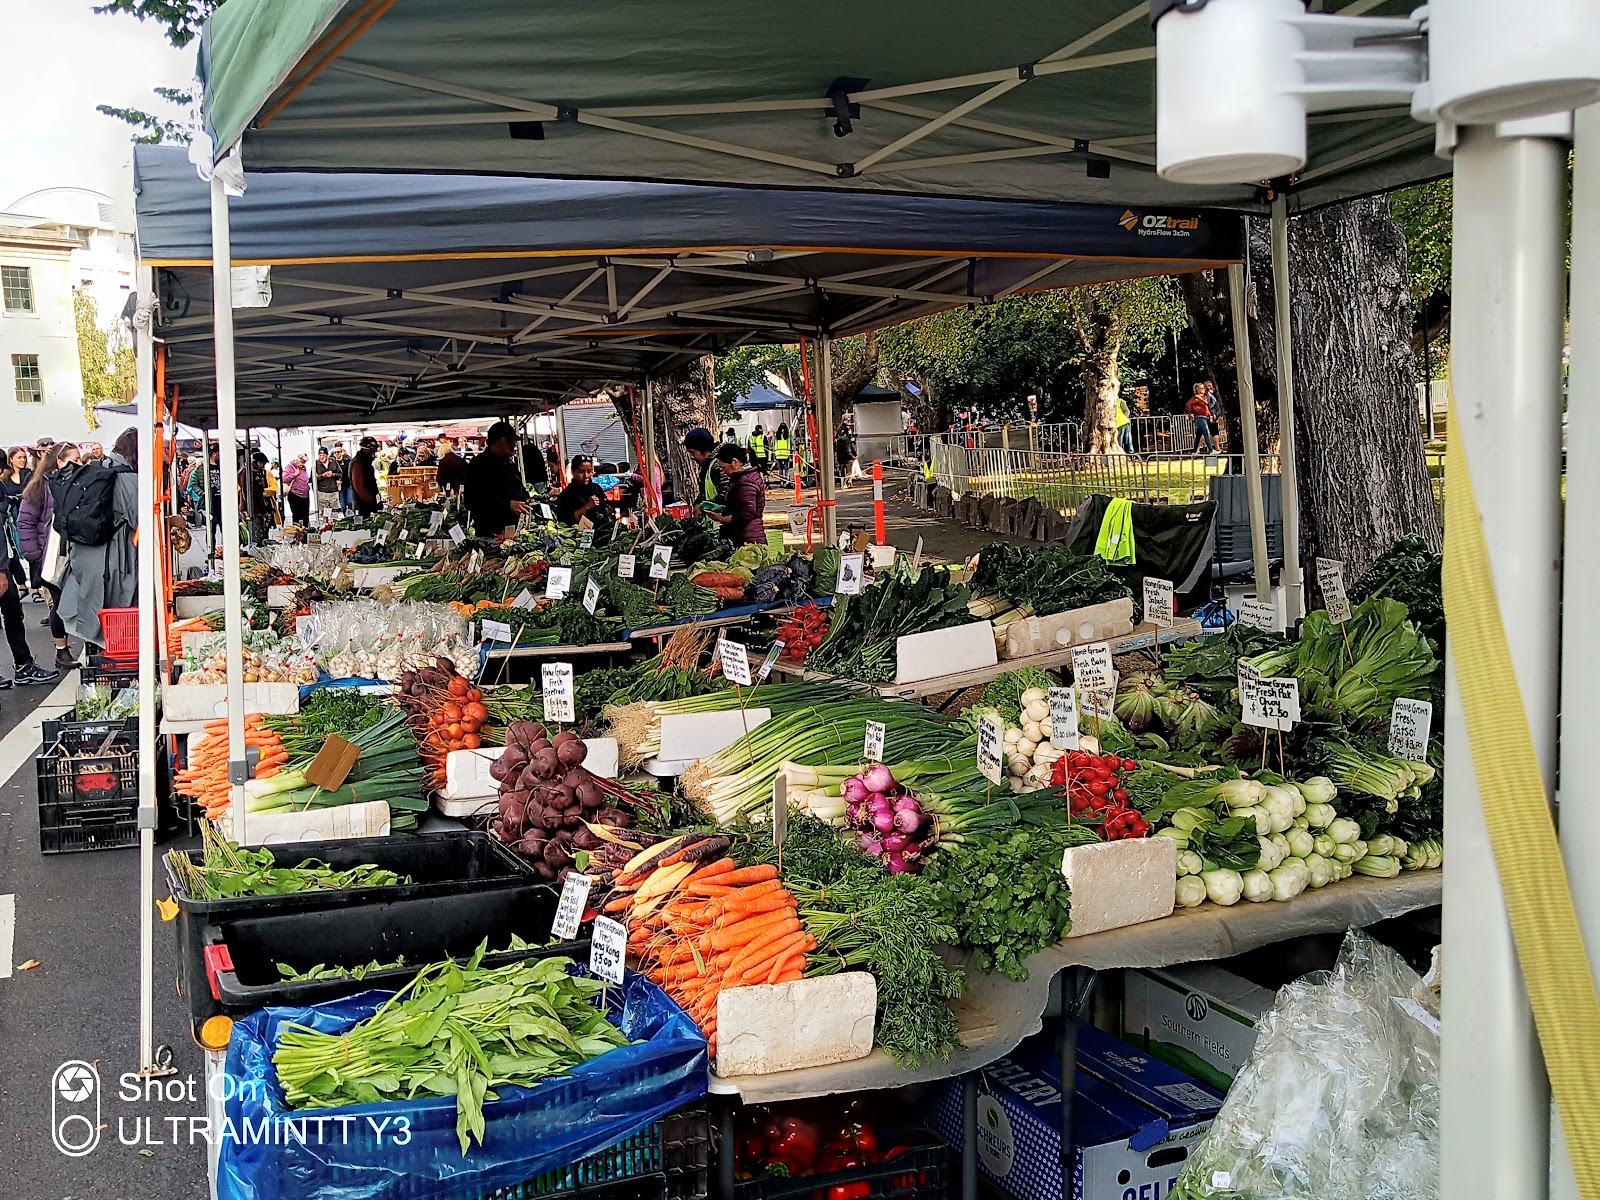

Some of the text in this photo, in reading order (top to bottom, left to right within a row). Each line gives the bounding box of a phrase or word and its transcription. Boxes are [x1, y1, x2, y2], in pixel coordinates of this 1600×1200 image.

[1142, 215, 1198, 229] OZtrail
[1138, 228, 1171, 236] HydroFlow
[1072, 645, 1107, 658] Home Grown
[1074, 656, 1107, 669] Fresh Baby
[1255, 679, 1295, 690] Home Grown
[1255, 687, 1292, 699] Fresh Pak
[1262, 706, 1289, 718] $2.50
[1394, 701, 1428, 716] Home Grown
[1395, 712, 1416, 726] Fresh
[1393, 724, 1417, 737] Tatsoi
[1162, 1014, 1230, 1060] Southern Fields
[1179, 1126, 1207, 1141] GROWN
